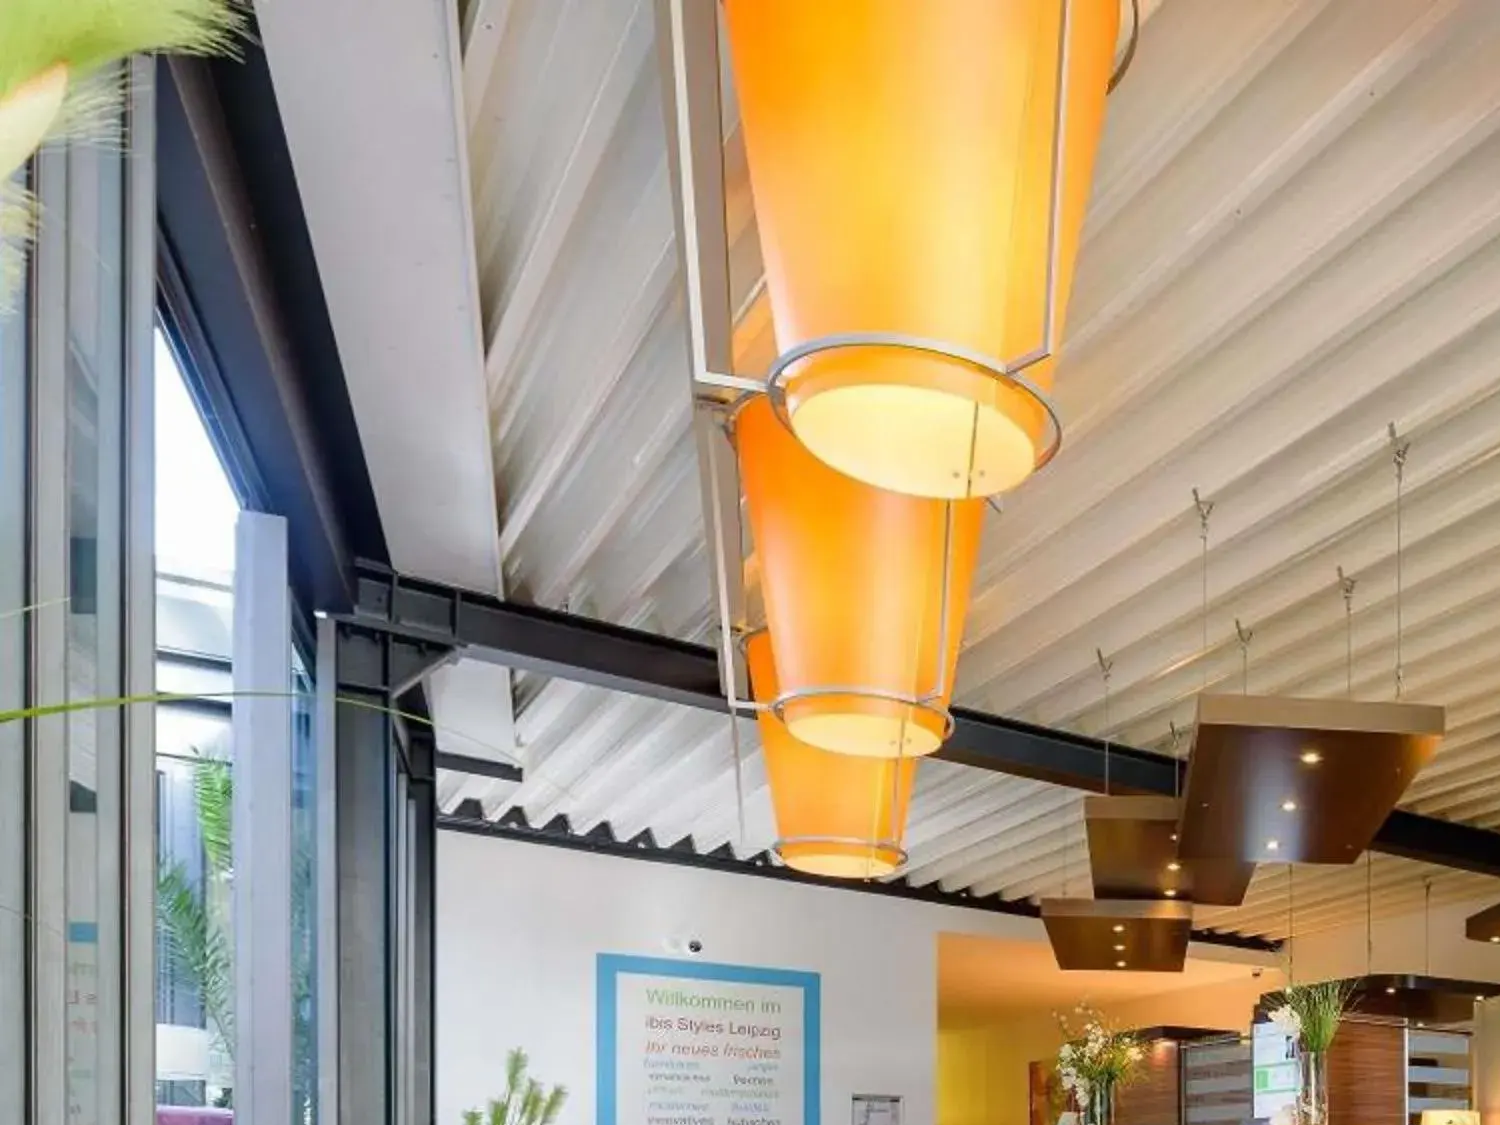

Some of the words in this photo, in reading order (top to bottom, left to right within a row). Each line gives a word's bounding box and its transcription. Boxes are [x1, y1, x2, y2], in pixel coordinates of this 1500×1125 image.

[645, 988, 755, 1012] Willkommen
[760, 998, 782, 1014] im
[645, 1015, 673, 1030] ibis
[677, 1017, 725, 1035] Styles
[729, 1021, 782, 1040] Leipzig
